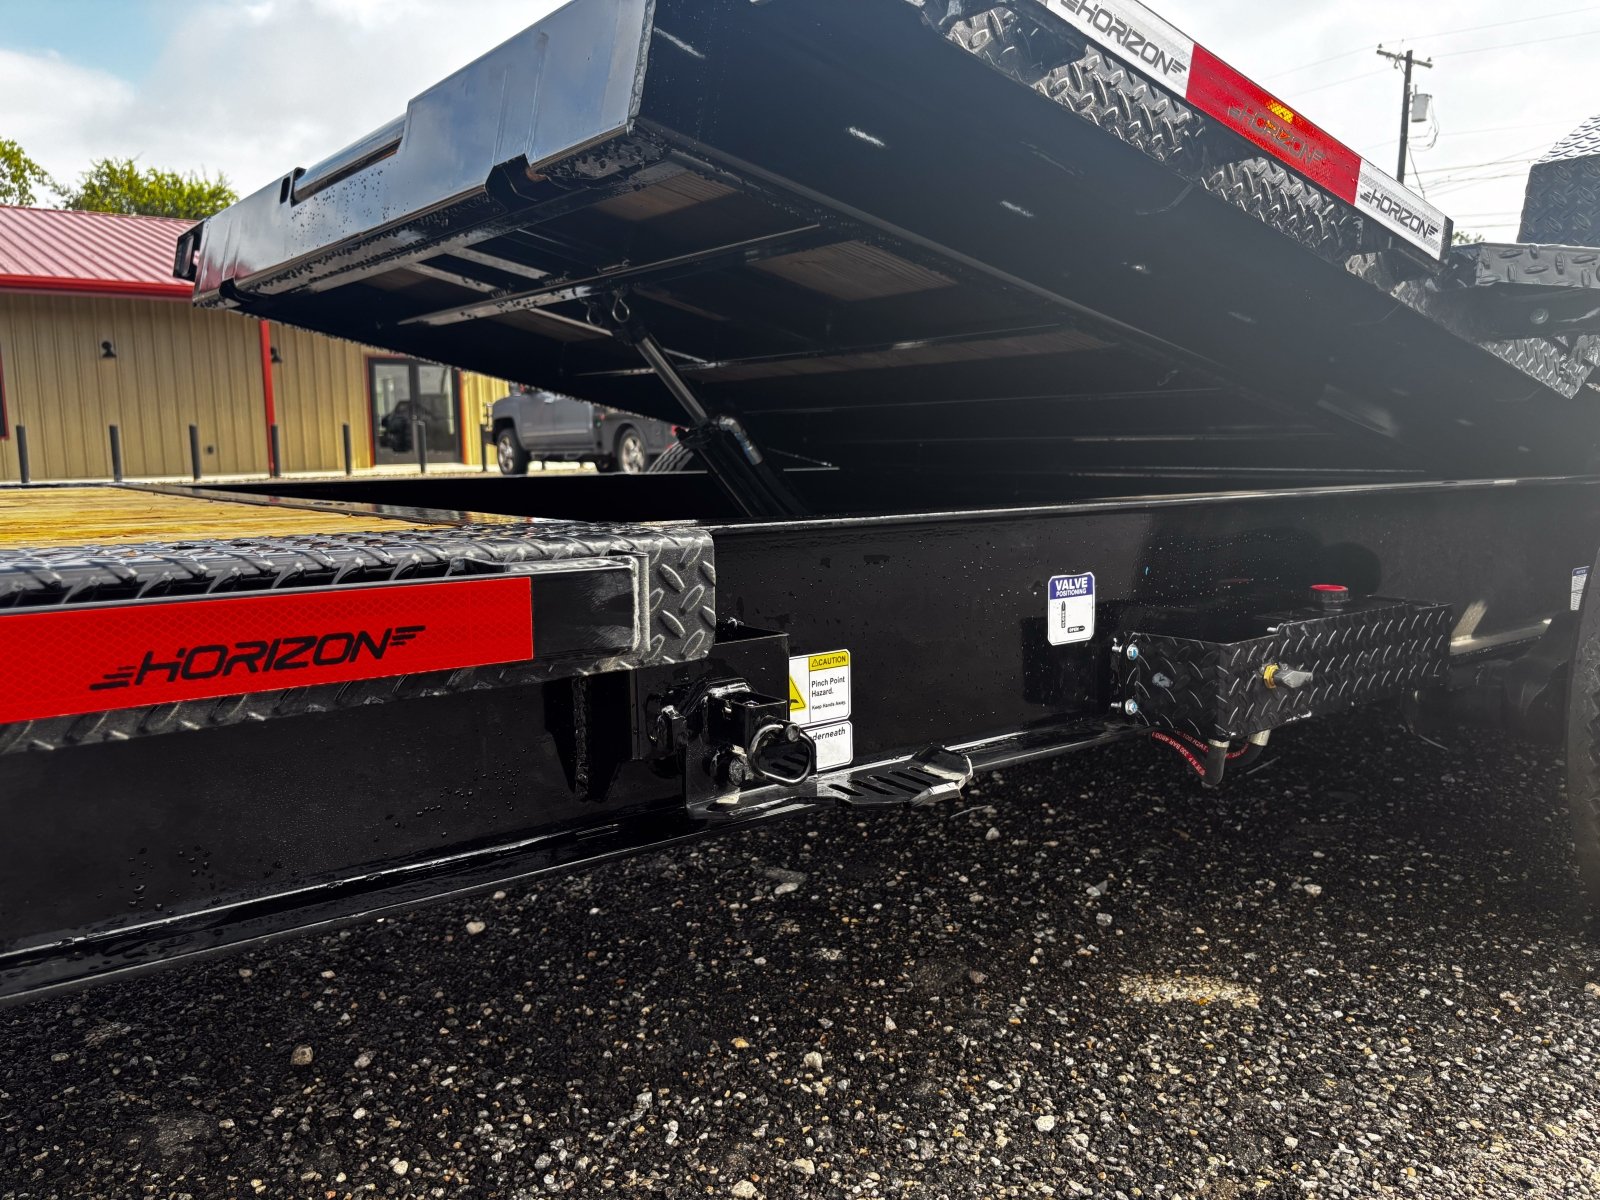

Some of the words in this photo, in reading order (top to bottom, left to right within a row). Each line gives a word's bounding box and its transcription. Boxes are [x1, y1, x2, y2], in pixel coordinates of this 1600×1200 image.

[1077, 0, 1172, 74] HORIZON
[1238, 103, 1316, 164] HORIZON
[1369, 187, 1430, 239] HORIZON
[1055, 577, 1088, 591] VALVE
[1056, 588, 1087, 597] POSITIONING
[135, 627, 391, 685] HORIZON
[818, 656, 846, 666] CAUTION
[811, 678, 828, 688] Pinch
[830, 676, 845, 686] Point
[811, 688, 834, 698] Hazard.
